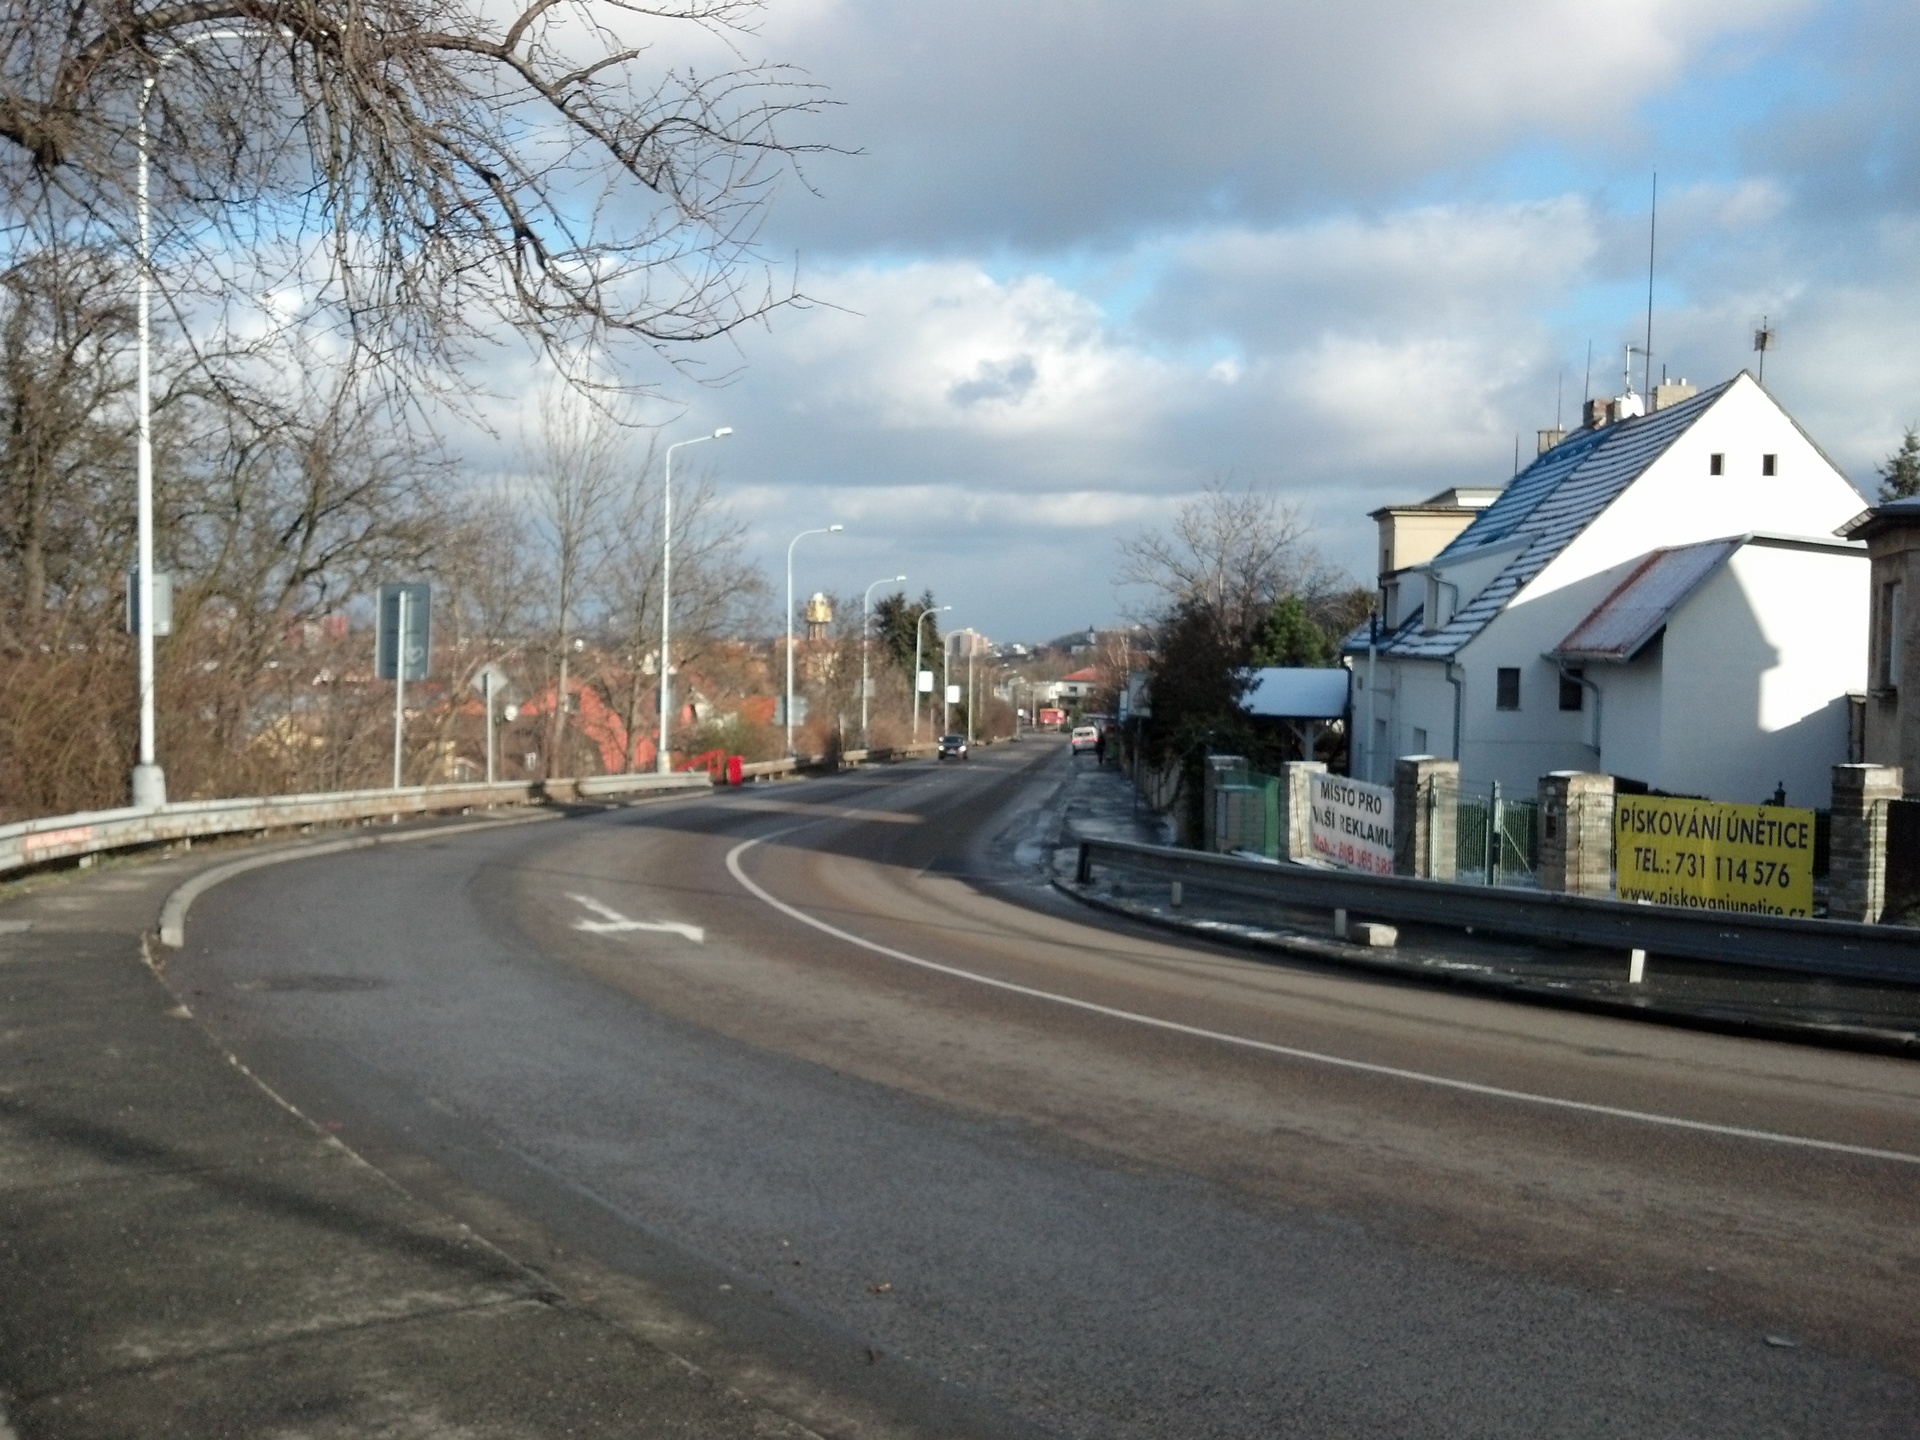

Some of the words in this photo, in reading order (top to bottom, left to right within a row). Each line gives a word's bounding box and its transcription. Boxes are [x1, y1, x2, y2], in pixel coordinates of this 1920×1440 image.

[1321, 779, 1355, 806] MÍSTO
[1359, 791, 1382, 815] PRO
[1620, 801, 1723, 841] PÍSKOVÁNÍ
[1726, 807, 1808, 849] ÚNĚTICE
[1634, 847, 1670, 874] TEL.:
[1675, 851, 1705, 879] 731
[1715, 855, 1747, 885] 114
[1753, 862, 1790, 889] 576
[1620, 886, 1806, 917] www.piskovaniuneticecz
